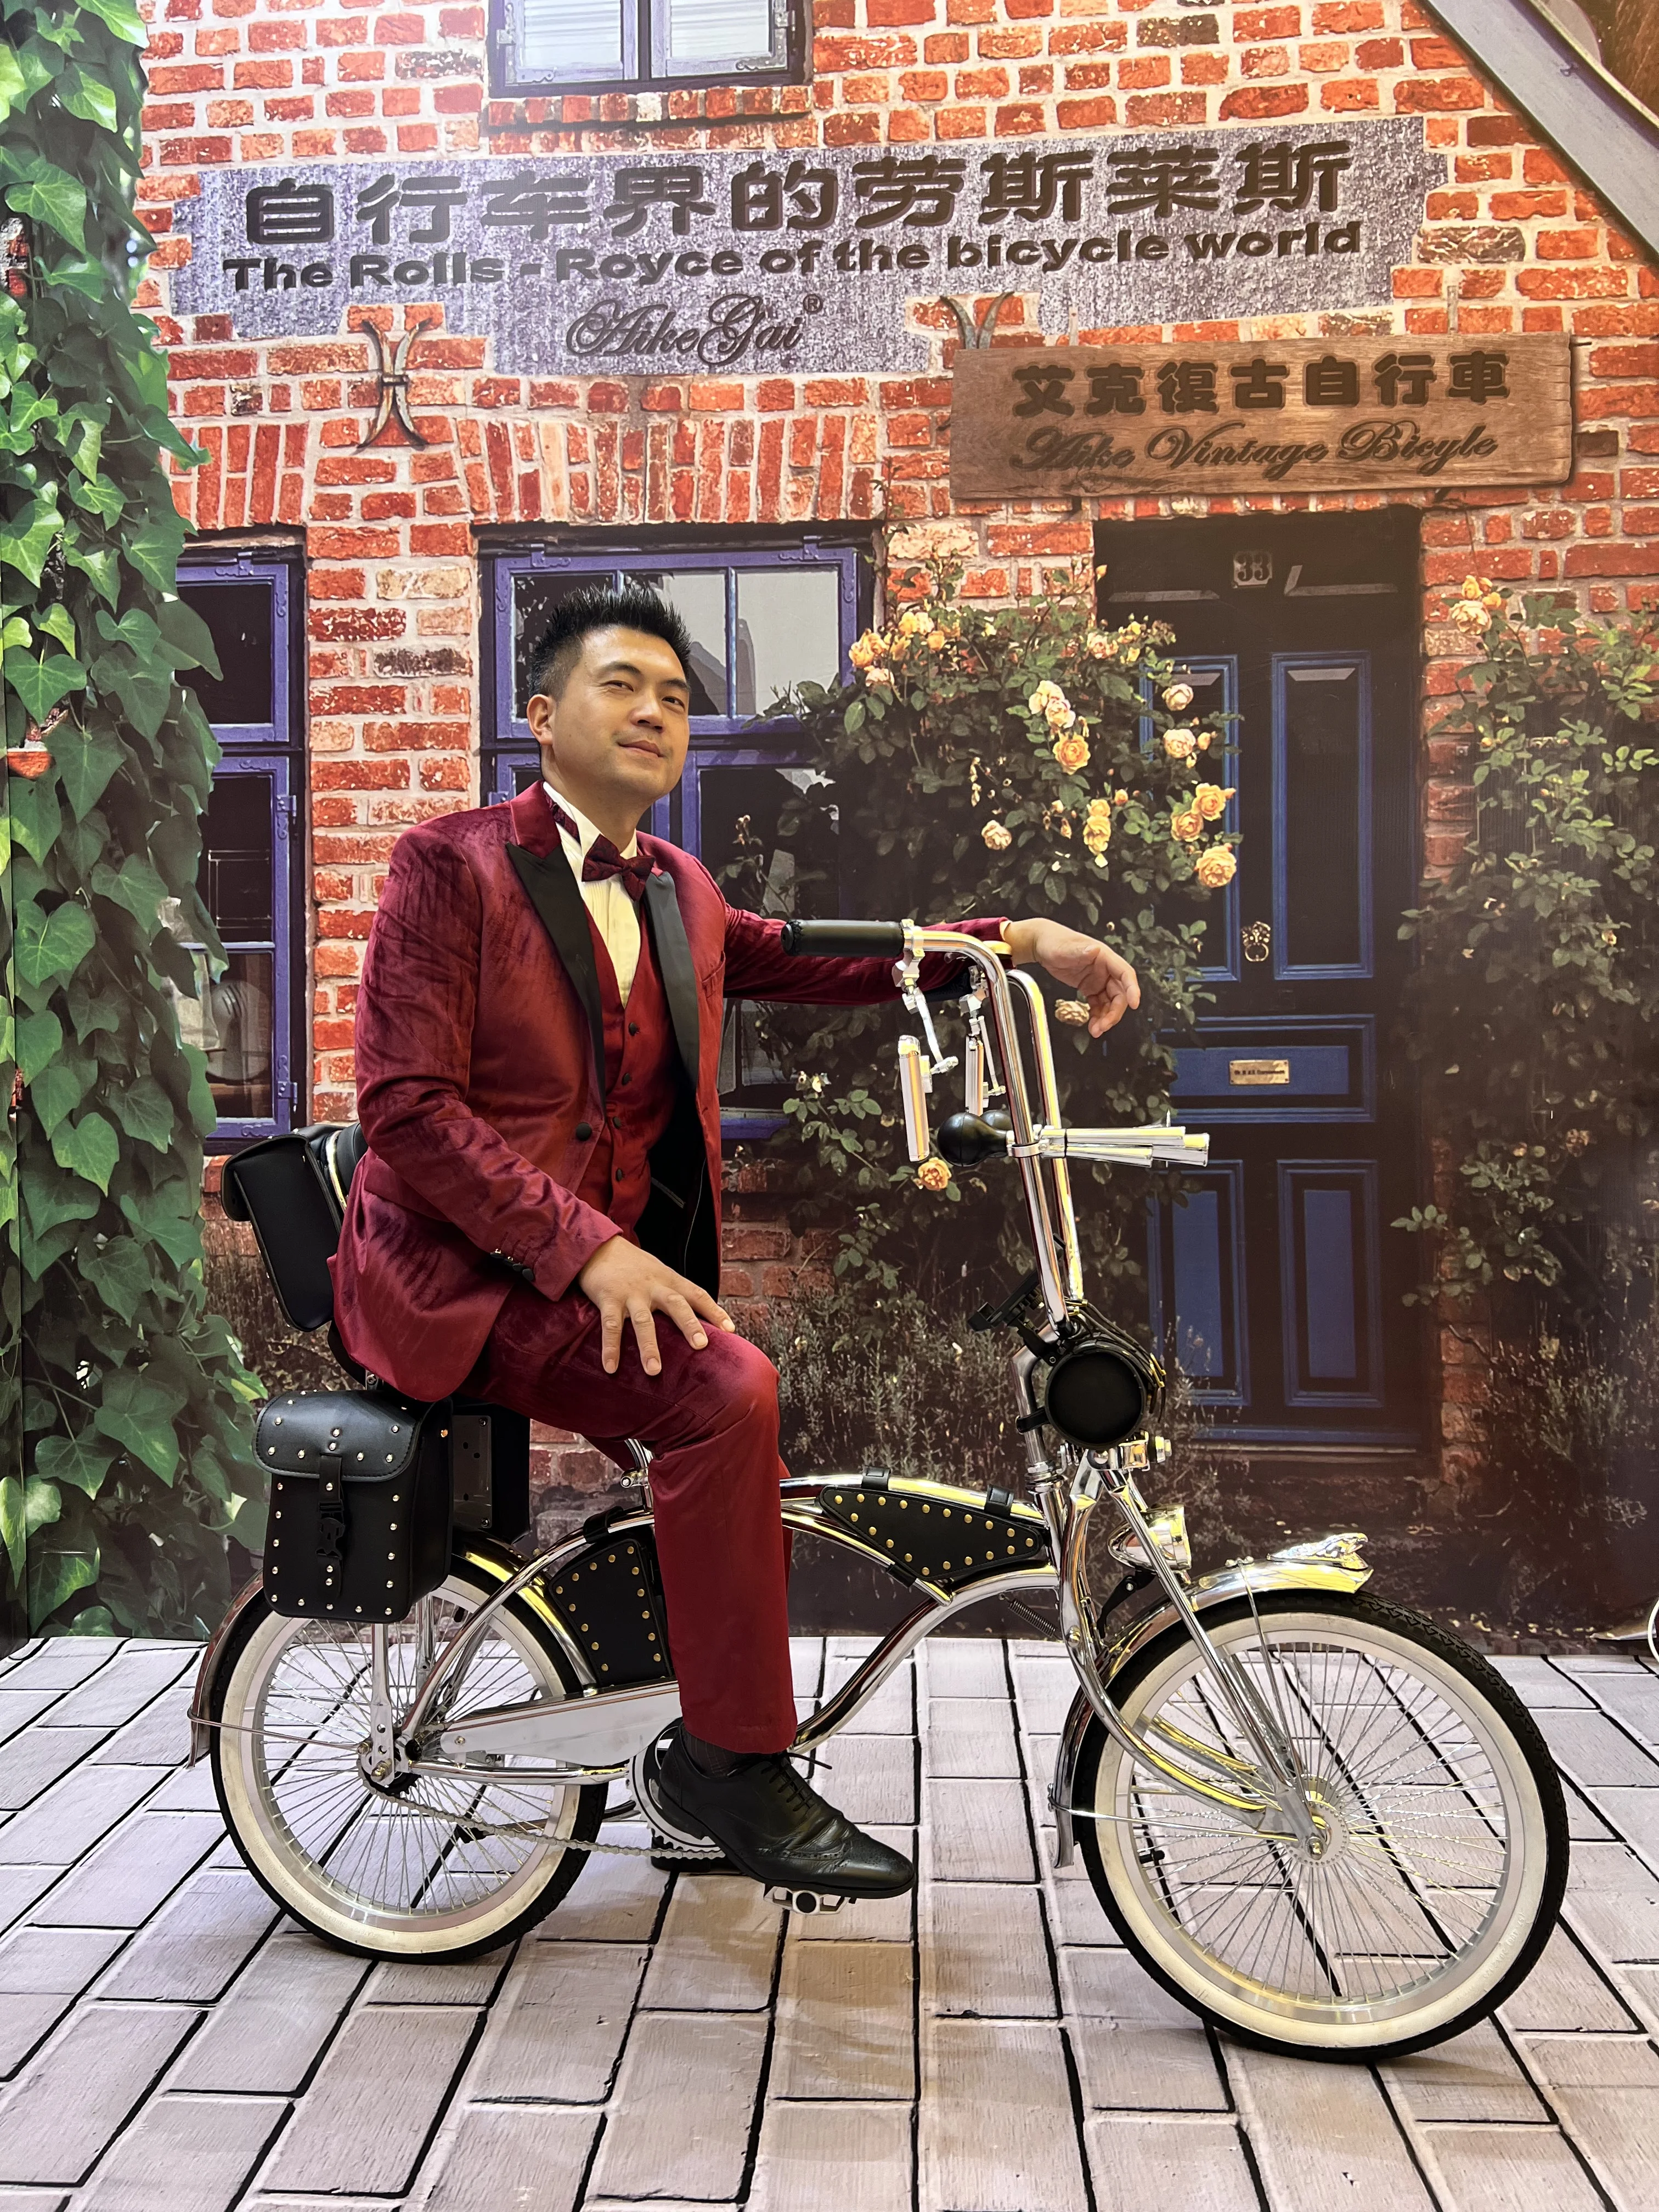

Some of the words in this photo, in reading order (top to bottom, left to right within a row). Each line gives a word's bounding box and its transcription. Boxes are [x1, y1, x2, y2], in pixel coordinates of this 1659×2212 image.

[246, 140, 1353, 245] 自行车界的劳斯莱斯
[222, 257, 333, 292] The
[349, 252, 504, 288] Rolls
[555, 248, 743, 286] Royce
[759, 240, 822, 274] of
[832, 239, 930, 273] the
[947, 229, 1170, 273] bicycle
[1184, 221, 1362, 262] world
[1012, 349, 1510, 417] 艾克復古自行車
[1008, 425, 1136, 472] Aike
[1146, 420, 1329, 481] Vintage
[1236, 553, 1270, 582] 33
